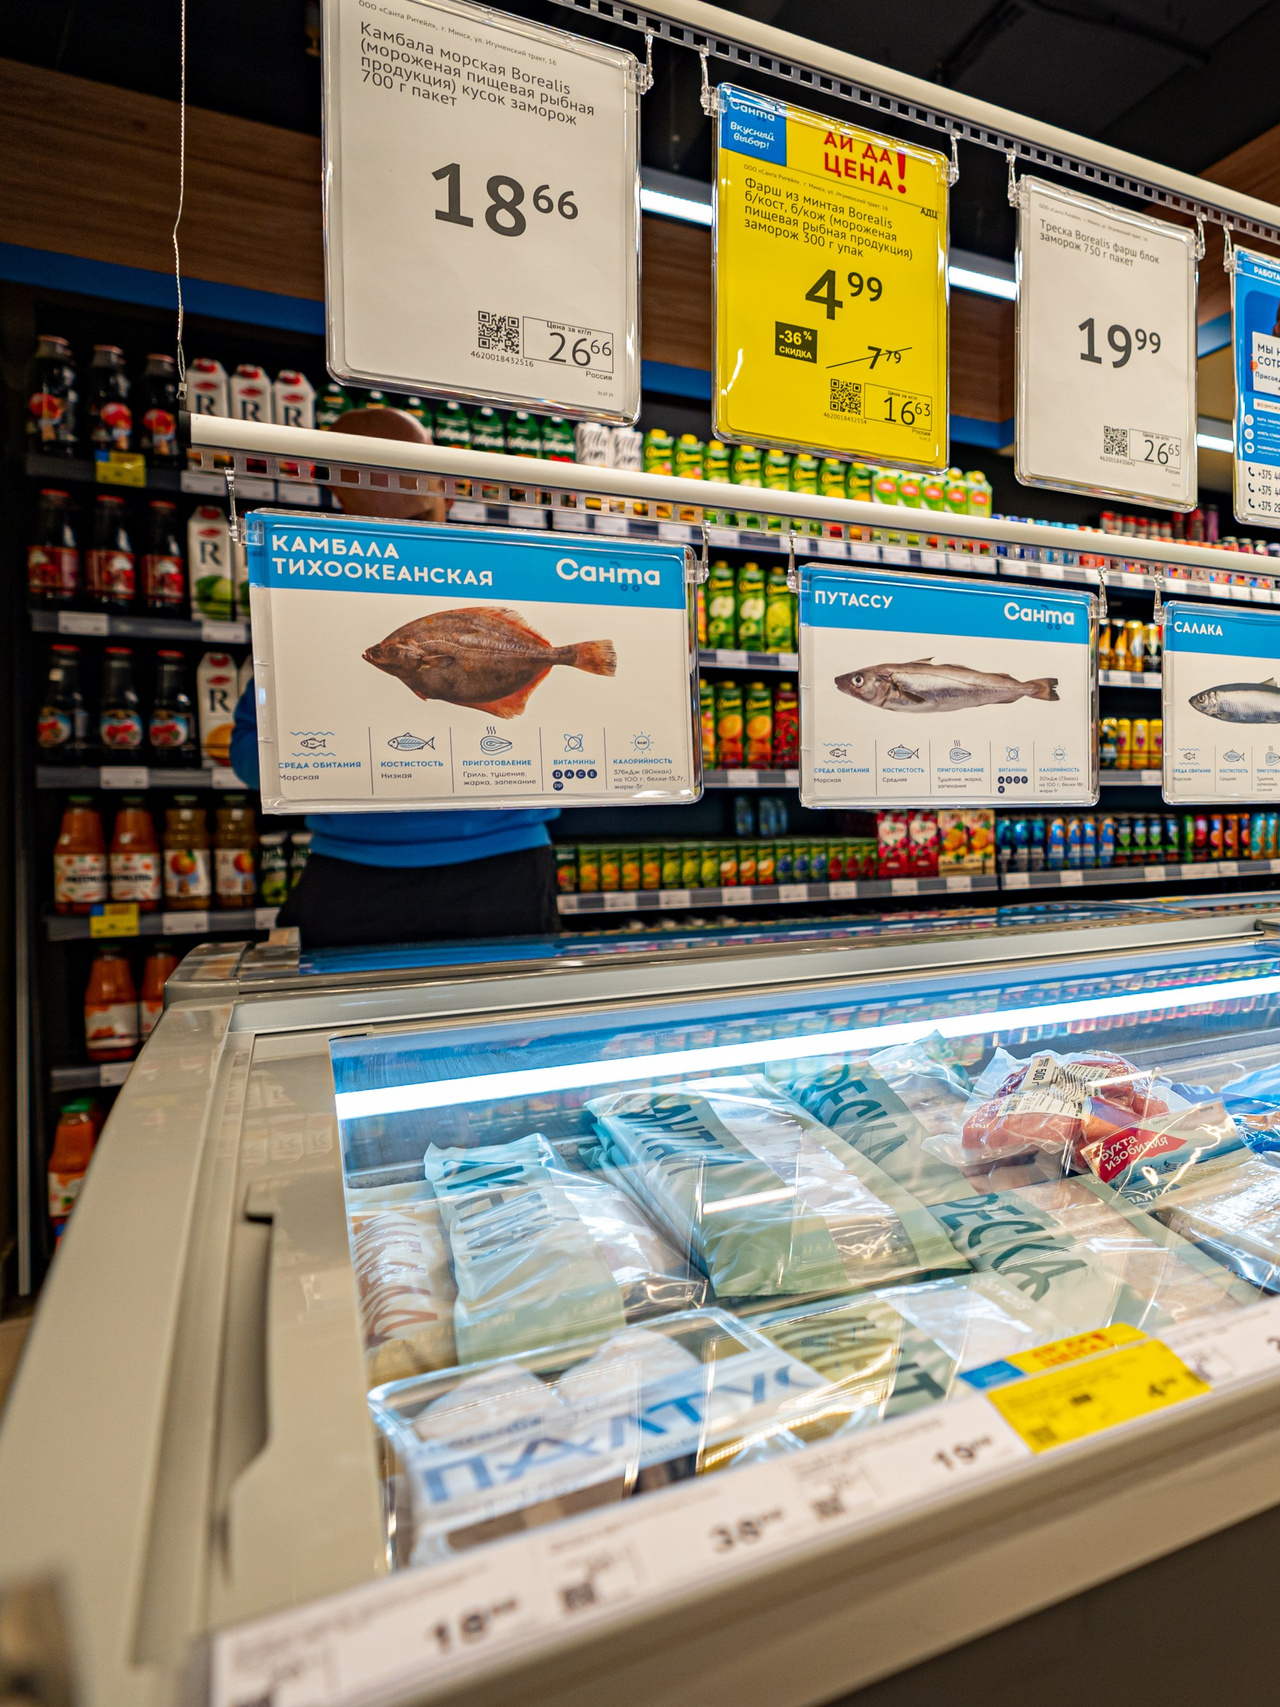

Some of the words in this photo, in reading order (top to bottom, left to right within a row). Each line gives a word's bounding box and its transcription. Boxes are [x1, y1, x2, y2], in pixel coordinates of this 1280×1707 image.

[360, 21, 434, 55] Камбала
[440, 49, 506, 77] морская
[512, 67, 570, 95] Borealis
[549, 57, 557, 66] 16
[361, 38, 461, 78] (мороженая
[467, 72, 535, 99] пищевая
[541, 92, 594, 116] рыбная
[361, 56, 456, 94] продукция)
[463, 85, 506, 105] кусок
[511, 98, 577, 125] заморож
[362, 70, 393, 90] 700
[400, 81, 406, 92] г
[412, 85, 457, 107] пакет
[730, 121, 774, 141] Вкусный
[734, 134, 769, 150] выбор!
[862, 143, 892, 165] ДА
[745, 177, 782, 199] Фарш
[786, 189, 799, 202] из
[803, 194, 845, 216] минтая
[849, 207, 893, 230] Borealis
[745, 190, 788, 213] б/кост,
[791, 204, 826, 223] б/кож
[829, 216, 897, 242] (мороженая
[745, 205, 799, 228] пищевая
[803, 222, 846, 240] рыбная
[850, 234, 913, 260] продукция)
[745, 218, 799, 241] заморож
[803, 232, 825, 247] 300
[829, 240, 834, 249] г
[837, 243, 864, 258] упак
[1040, 219, 1073, 238] Треска
[1075, 229, 1110, 249] Borealis
[1113, 243, 1137, 257] фарш
[1139, 251, 1159, 265] блок
[1040, 233, 1081, 252] заморож
[1084, 244, 1100, 256] 750
[1110, 254, 1134, 267] пакет
[1254, 266, 1280, 281] РАБОТА
[547, 321, 566, 332] Цена
[779, 345, 812, 360] СКИДКА
[1257, 344, 1273, 355] МЫ
[586, 371, 613, 381] Россия
[912, 428, 931, 436] Россия
[1258, 469, 1271, 481] +375
[1258, 485, 1272, 497] +375
[1258, 501, 1271, 512] +375
[1274, 503, 1280, 513] 29
[272, 534, 400, 560] КАМБАЛА
[272, 557, 494, 587] ТИХООКЕАНСКАЯ
[556, 557, 660, 587] Санта
[814, 590, 893, 609] ПУТАССУ
[1004, 602, 1075, 625] Санта
[1174, 621, 1223, 636] САЛАКА
[312, 761, 361, 769] ОБИТАНИЯ
[380, 760, 444, 768] КОСТИСТОСТЬ
[462, 759, 532, 767] ПРИГОТОВЛЕНИЕ
[613, 757, 673, 765] КАЛОРИЙНОСТЬ
[279, 773, 320, 782] Морская
[463, 770, 489, 781] Гриль,
[491, 770, 528, 779] тушение,
[463, 779, 493, 787] жарка,
[494, 778, 537, 786] запекание
[882, 776, 908, 784] Средняя
[937, 776, 963, 784] Тушение,
